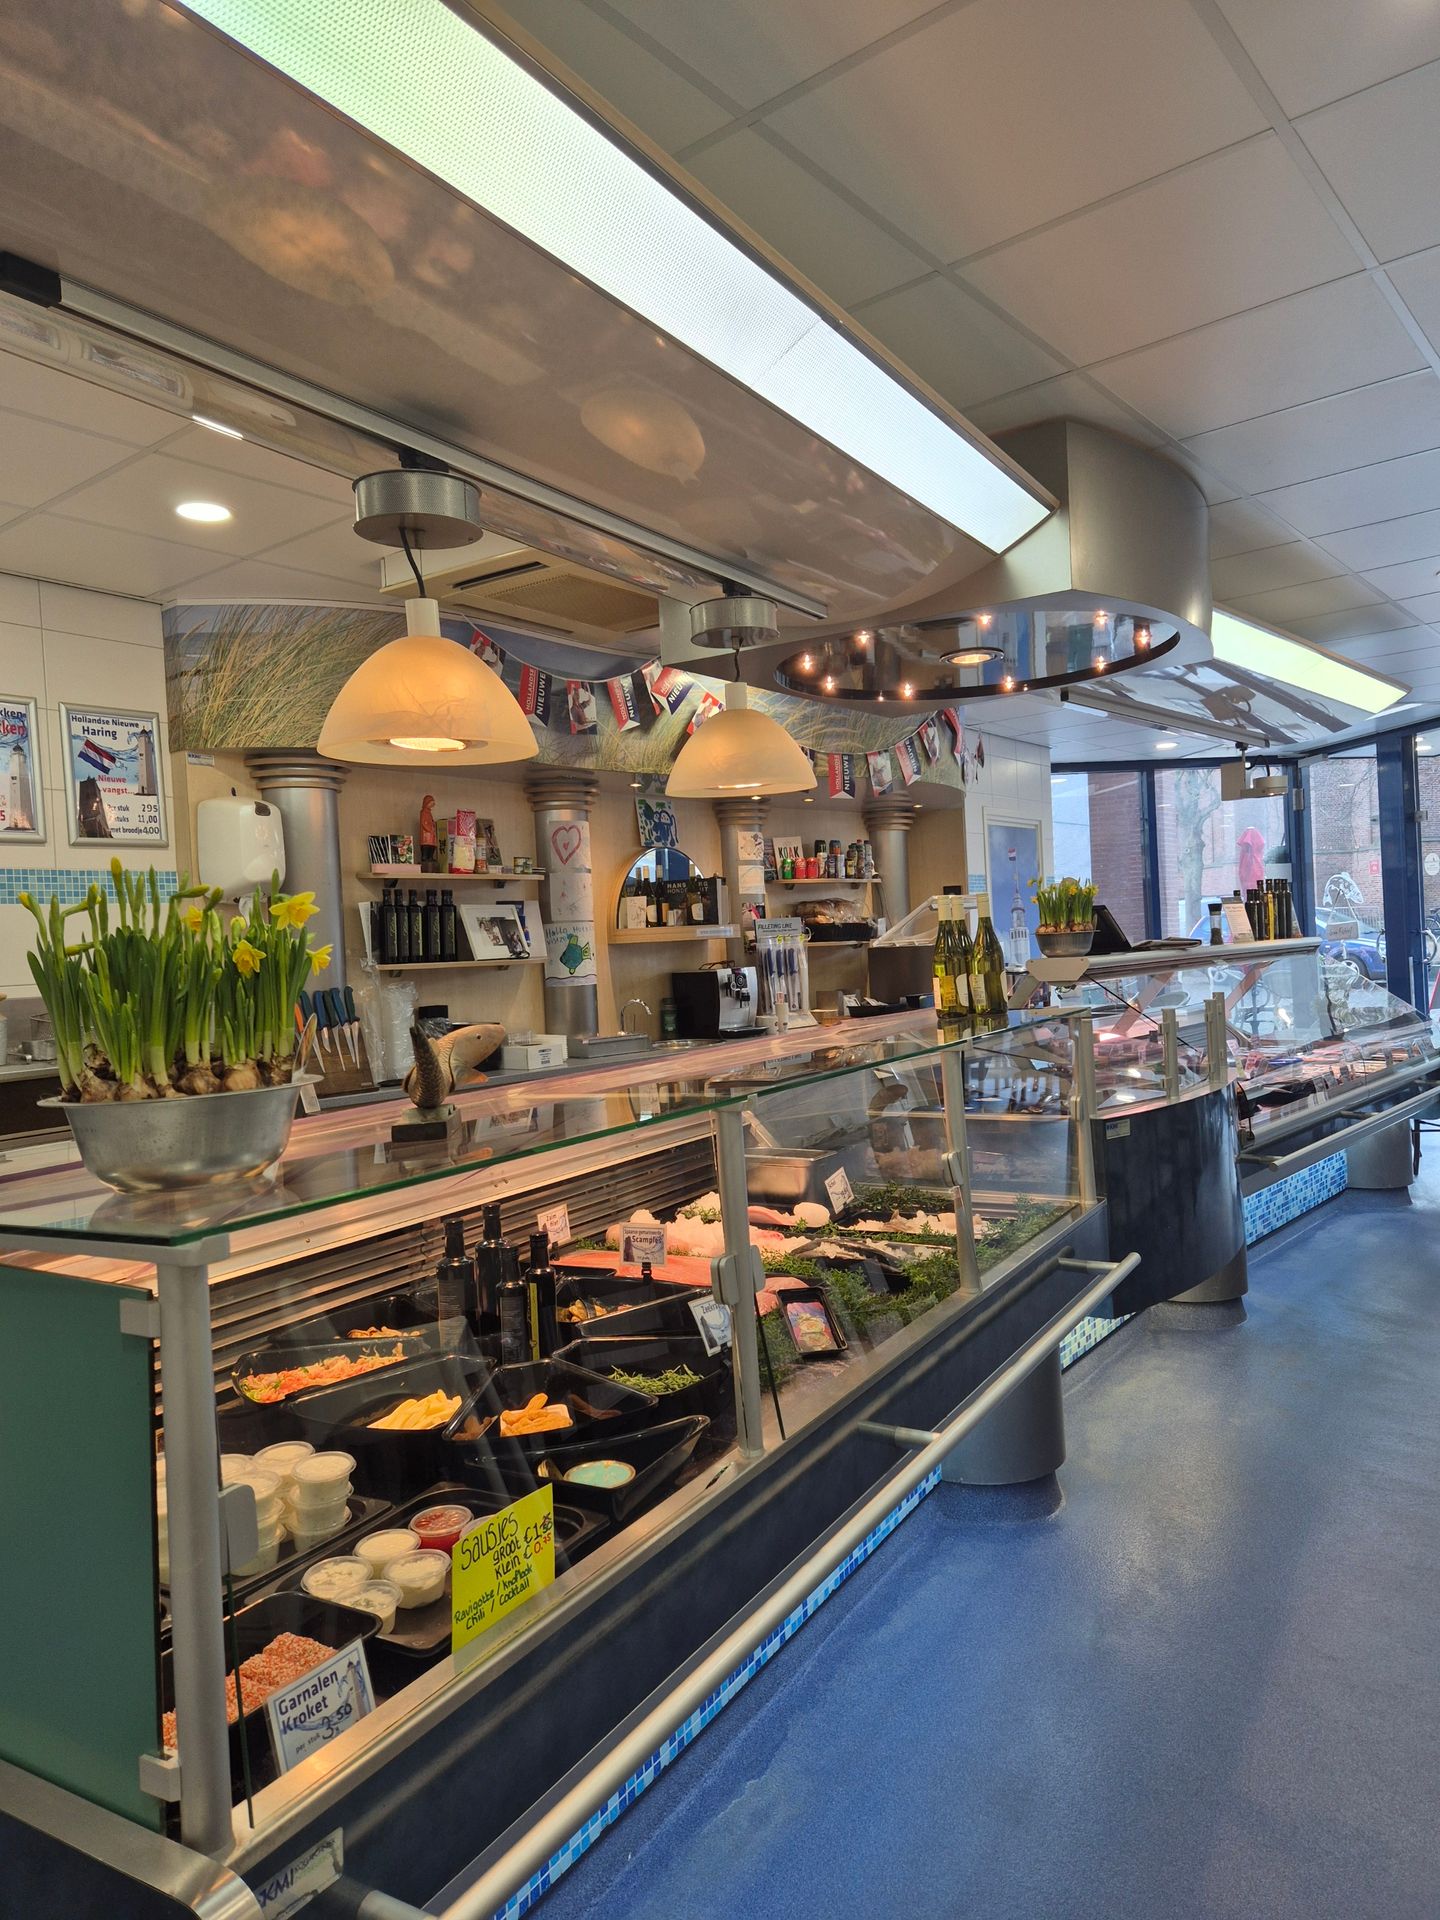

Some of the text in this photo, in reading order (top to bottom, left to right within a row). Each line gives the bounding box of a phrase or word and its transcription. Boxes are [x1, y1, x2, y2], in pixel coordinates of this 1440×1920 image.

[536, 672, 547, 715] NIEUWE
[71, 714, 139, 728] Hollandse Nieuwe
[81, 726, 118, 740] Haring
[97, 774, 127, 783] Nieuwe
[842, 754, 850, 791] NIEUWE
[122, 825, 143, 835] broodje
[778, 846, 800, 860] KOAK
[278, 1670, 339, 1716] Garnalen
[281, 1695, 329, 1735] Kroket
